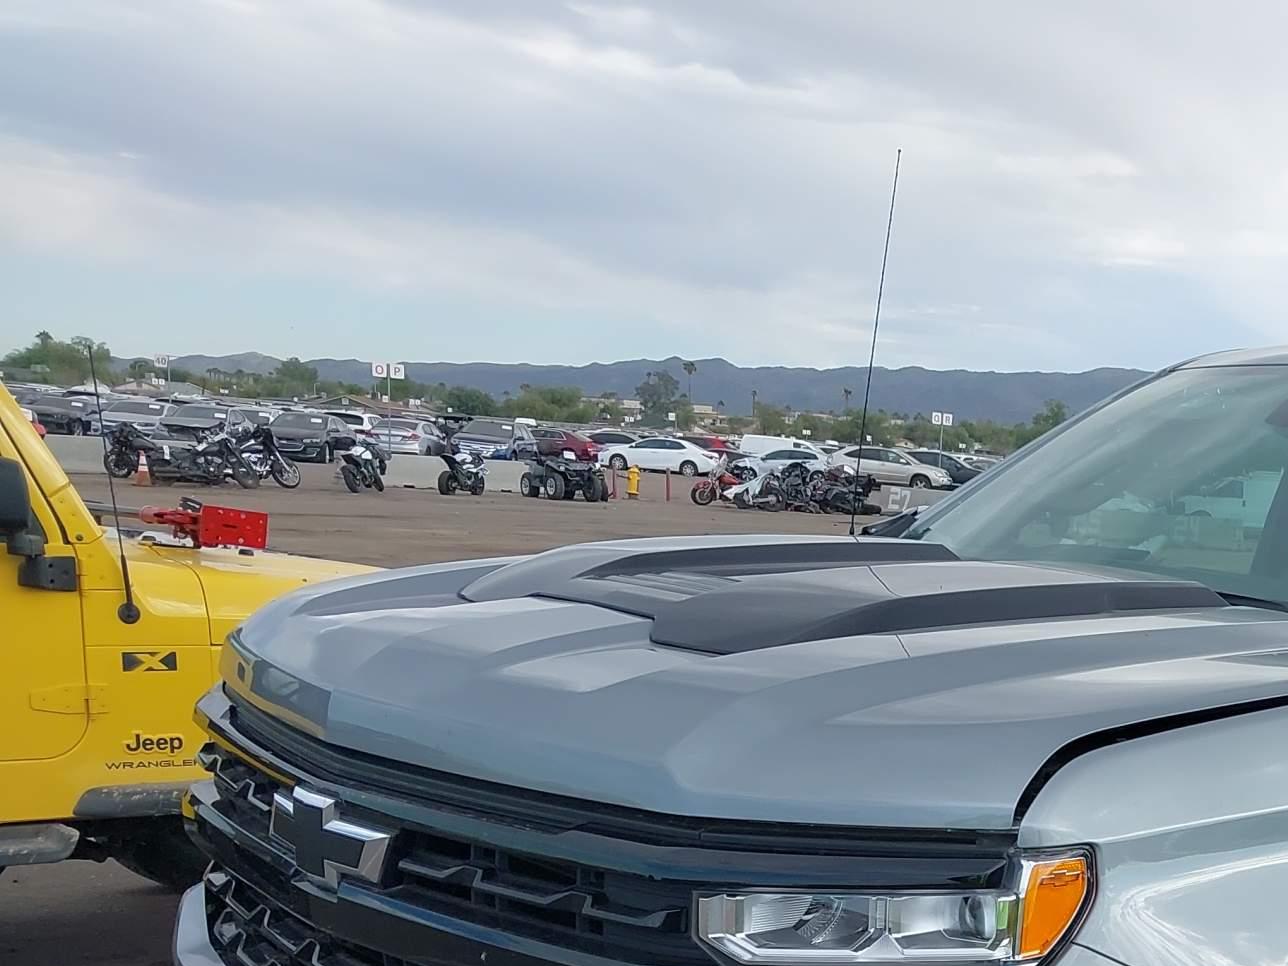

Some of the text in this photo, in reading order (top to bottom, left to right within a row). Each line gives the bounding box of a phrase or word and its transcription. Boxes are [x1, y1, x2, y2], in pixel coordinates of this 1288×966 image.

[393, 366, 401, 376] P
[944, 415, 951, 424] R
[888, 486, 911, 511] 27
[126, 733, 184, 754] Jeep
